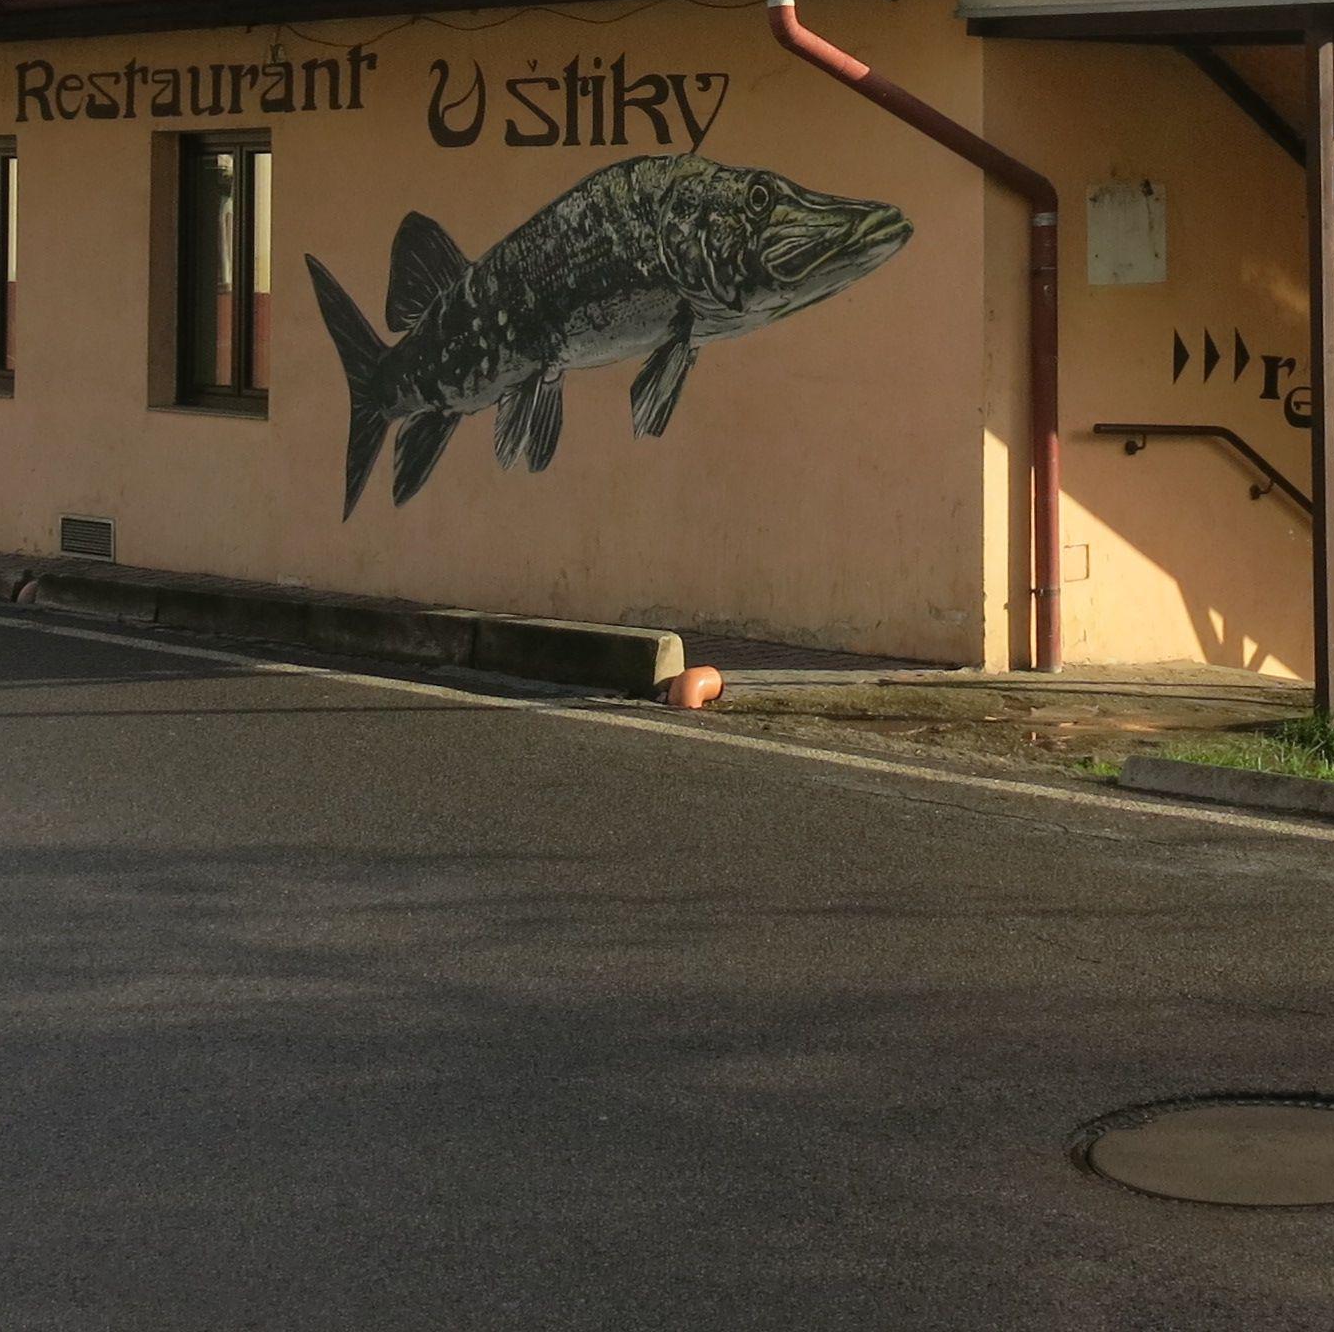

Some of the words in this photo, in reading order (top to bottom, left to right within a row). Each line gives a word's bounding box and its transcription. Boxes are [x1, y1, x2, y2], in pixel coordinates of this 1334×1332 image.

[15, 43, 378, 122] Restaurant
[427, 58, 486, 148] U
[504, 52, 729, 155] Štiky
